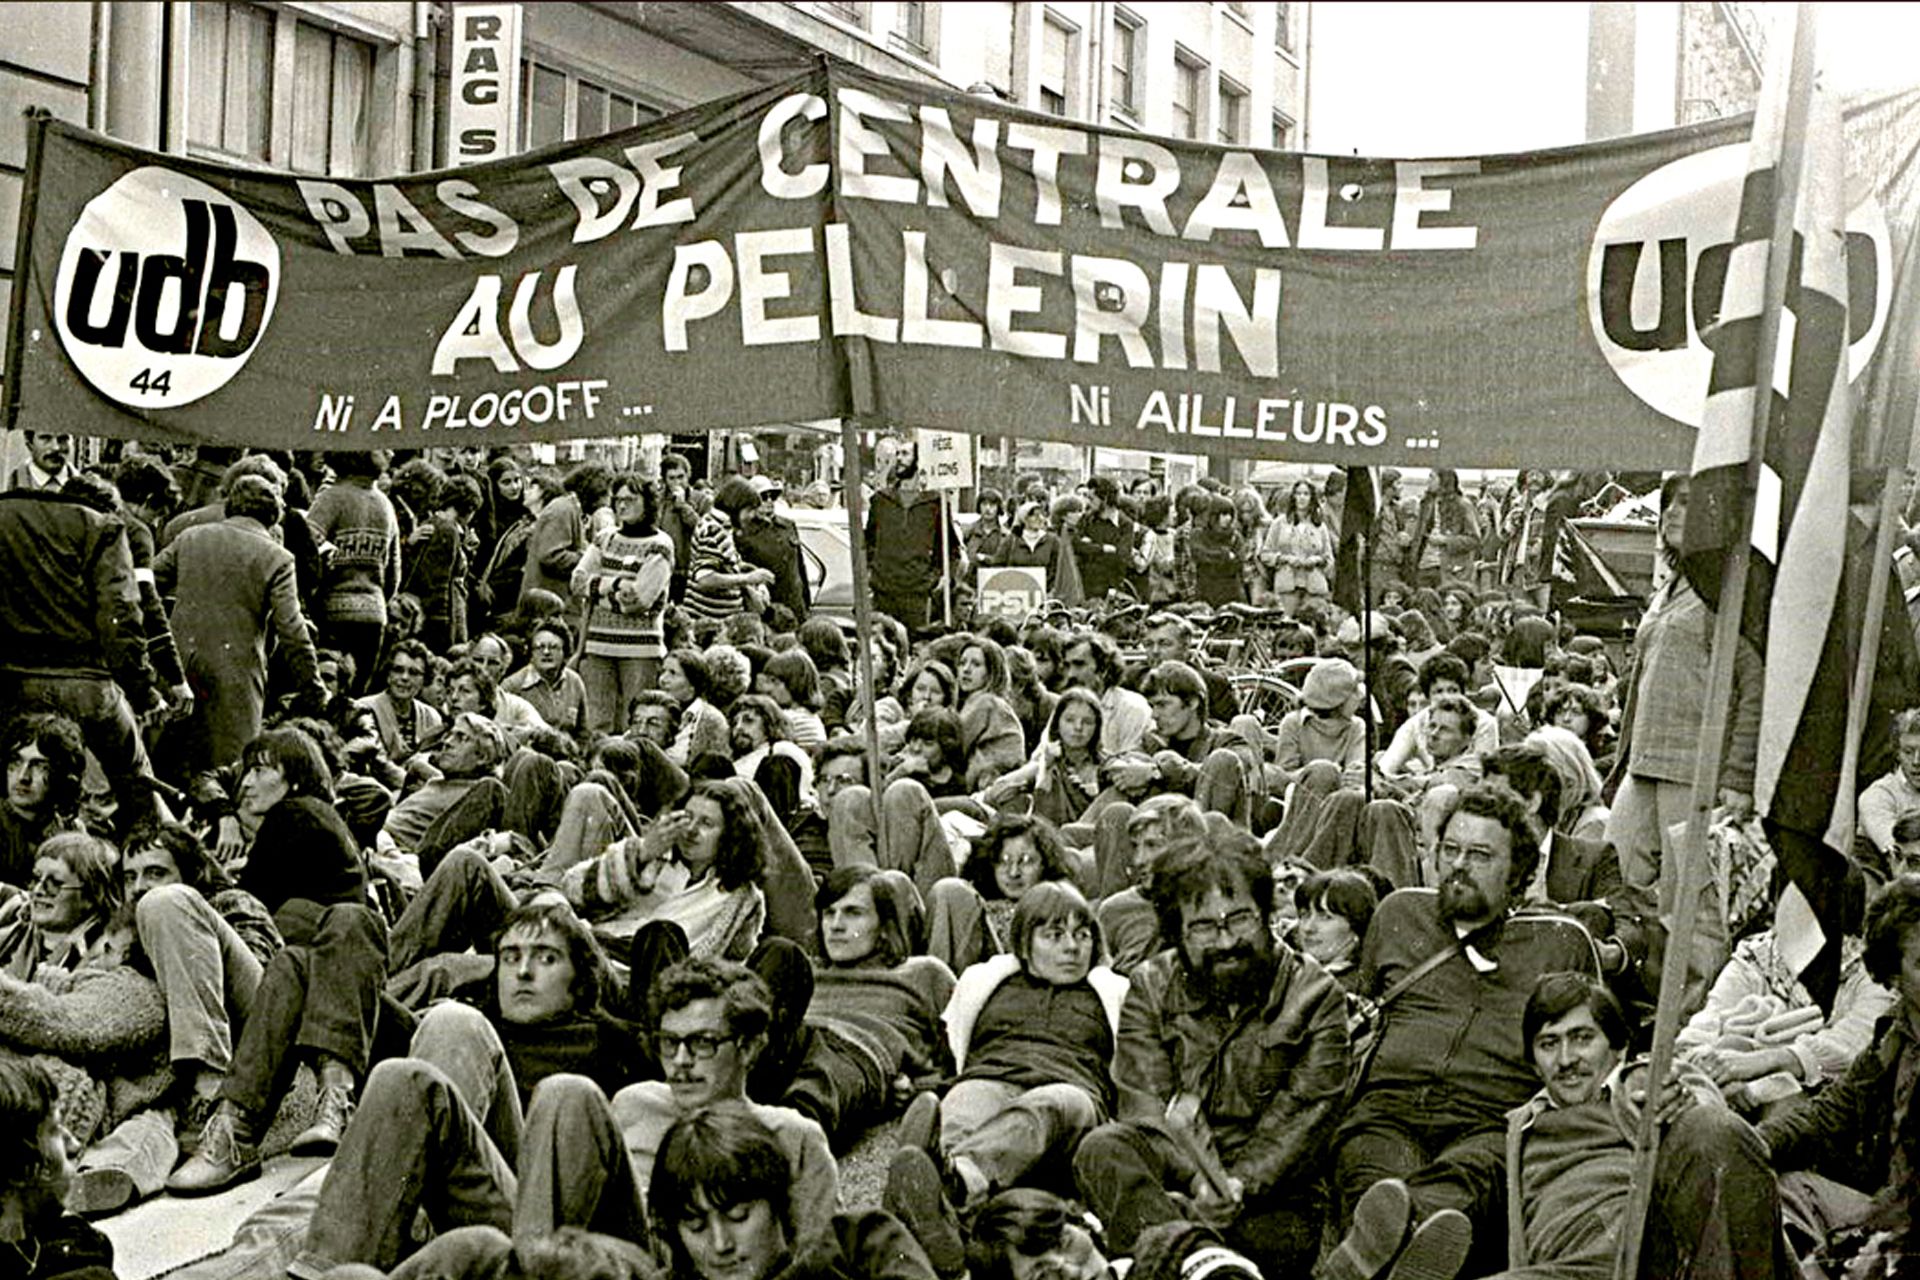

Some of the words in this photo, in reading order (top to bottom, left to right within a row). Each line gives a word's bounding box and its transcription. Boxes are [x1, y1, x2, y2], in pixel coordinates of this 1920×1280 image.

[461, 16, 502, 106] RAG
[296, 179, 519, 260] PAS
[548, 131, 699, 244] DE
[757, 86, 1482, 251] CENTRALE
[430, 264, 586, 377] AU
[662, 221, 1283, 379] PELLERIN
[129, 368, 171, 397] 44
[371, 395, 402, 431] A
[422, 380, 609, 430] PLOGOFF
[982, 590, 1042, 615] PSU
